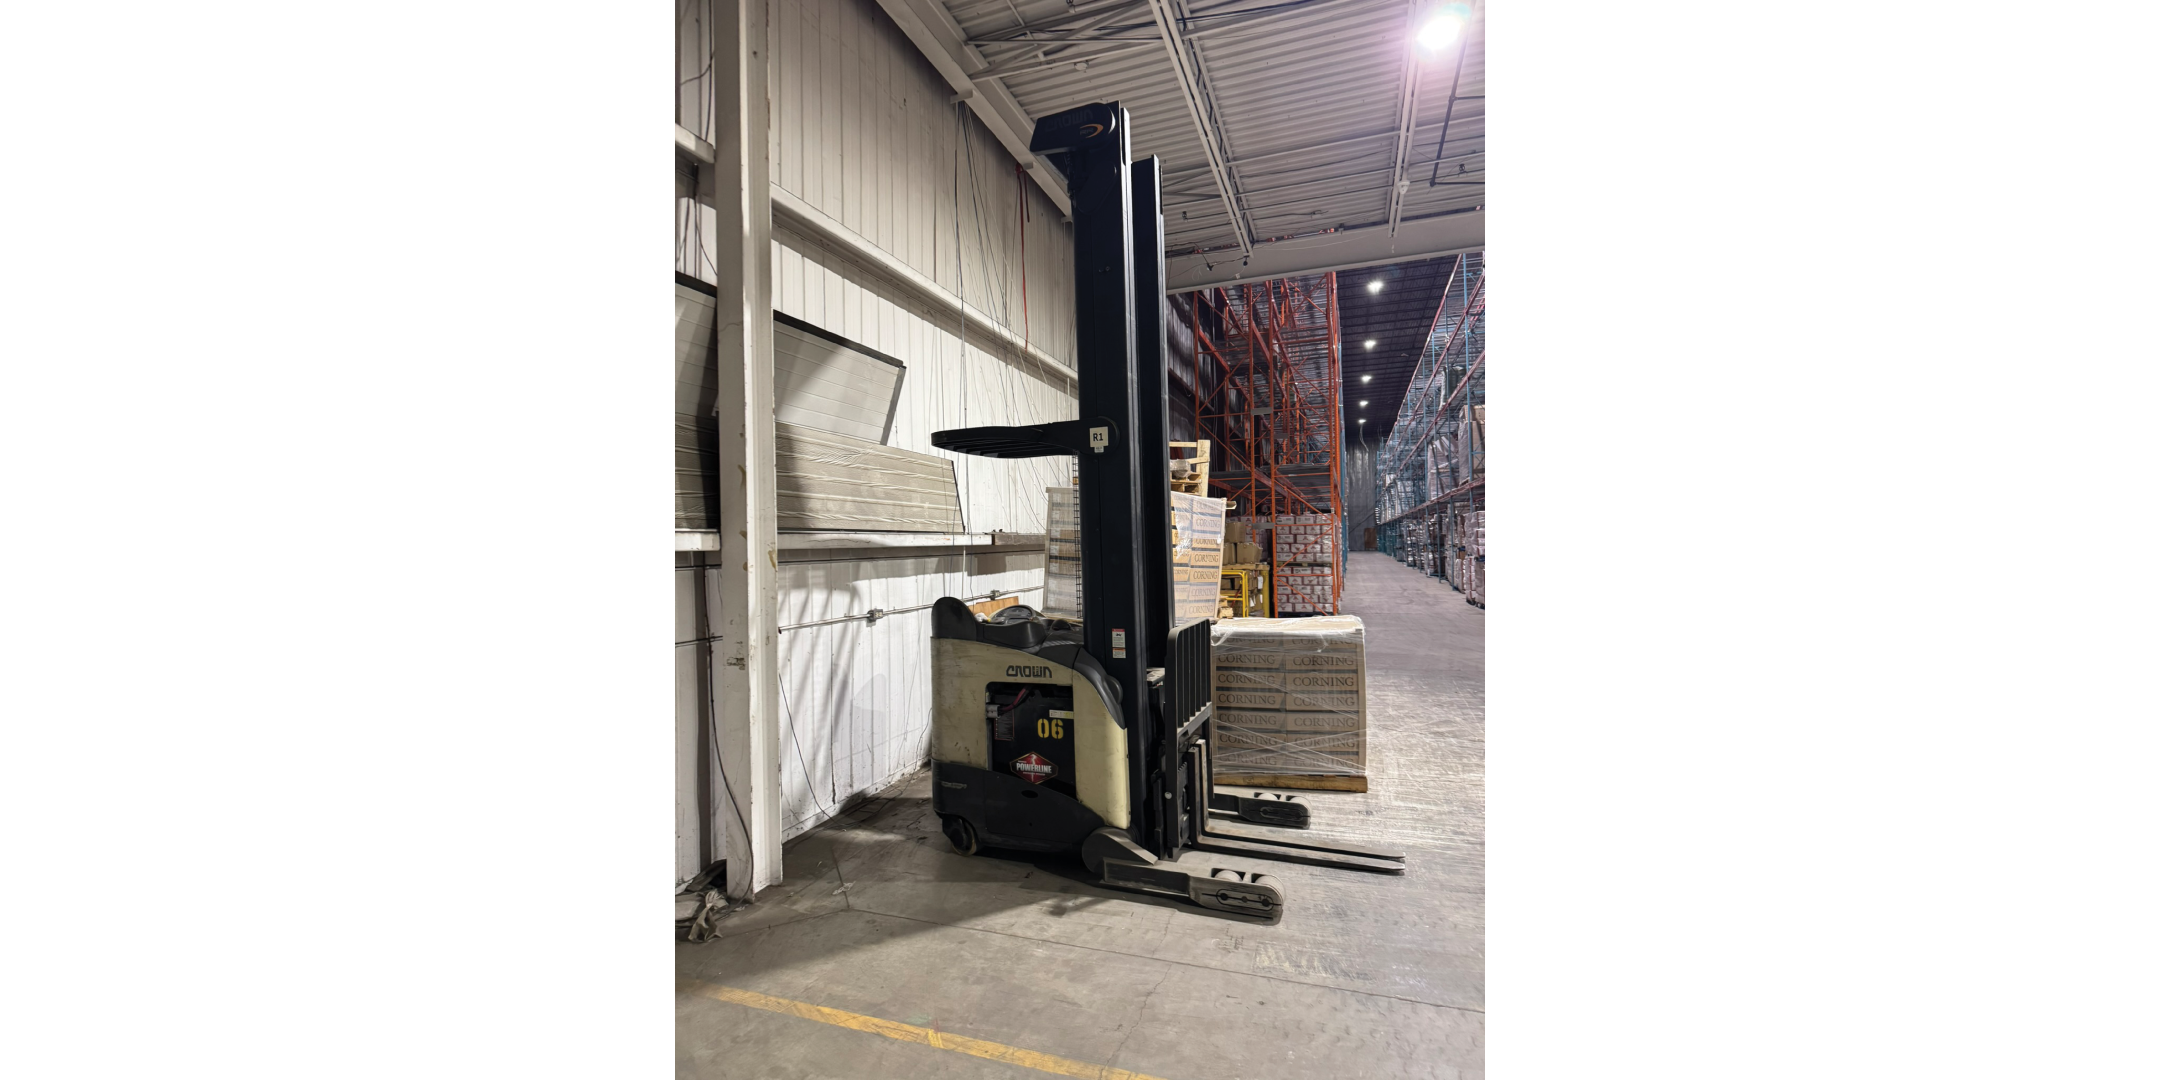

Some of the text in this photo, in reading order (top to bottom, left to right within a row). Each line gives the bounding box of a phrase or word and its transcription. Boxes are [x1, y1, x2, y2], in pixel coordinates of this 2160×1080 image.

[1045, 109, 1094, 132] CROWN
[1092, 432, 1104, 442] R1
[1195, 519, 1220, 528] CORNING
[1194, 553, 1219, 563] CORNING
[1192, 570, 1218, 580] CORNING
[1218, 653, 1276, 665] CORNING
[1292, 654, 1354, 666] CORNING
[1005, 665, 1053, 679] CROWN
[1217, 673, 1276, 684] CORNING
[1293, 676, 1354, 687] CORNING
[1218, 693, 1276, 705] CORNING
[1293, 696, 1355, 707] CORNING
[1218, 713, 1277, 726] CORNING
[1294, 717, 1356, 728] CORNING
[1037, 718, 1064, 739] 06
[1219, 734, 1278, 746] CORNING
[1294, 737, 1356, 748] CORNING
[1016, 762, 1052, 774] POWERLINE
